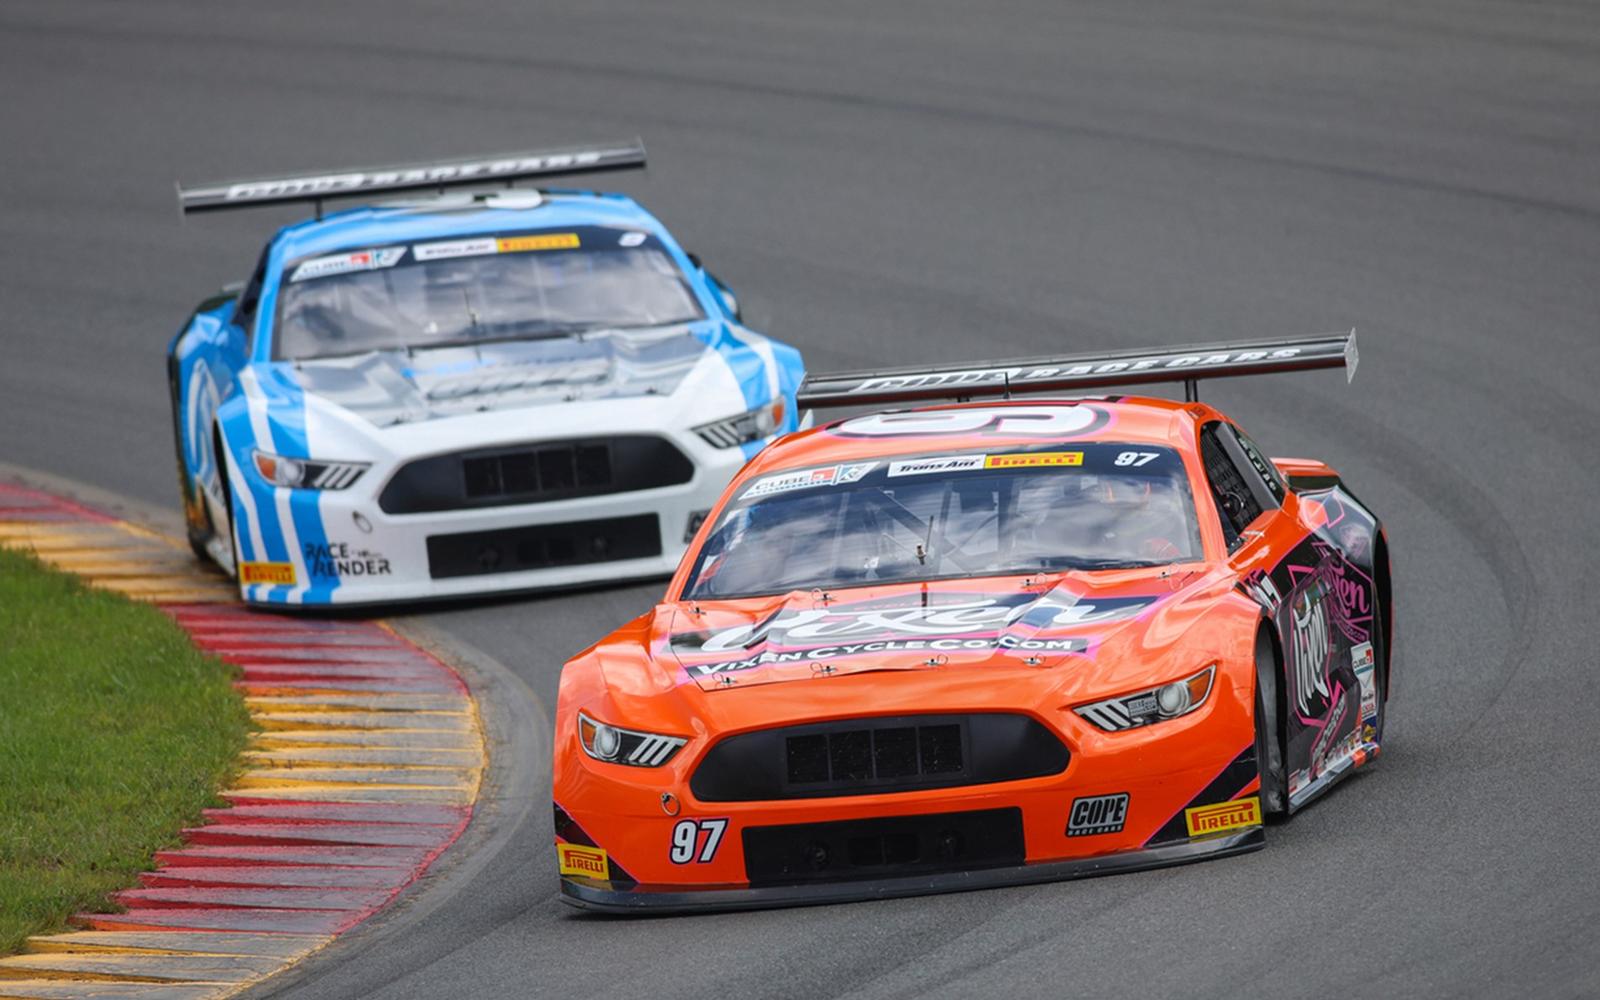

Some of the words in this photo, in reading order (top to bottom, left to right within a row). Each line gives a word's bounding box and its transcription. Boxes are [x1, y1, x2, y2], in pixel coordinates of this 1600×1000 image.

[991, 455, 1077, 467] PIRELLI
[1114, 451, 1161, 467] 97
[304, 542, 348, 560] RACE
[1071, 797, 1127, 827] COPE
[1190, 803, 1255, 832] PIRELLI
[669, 817, 730, 865] 97
[563, 850, 604, 873] PIRELLI
